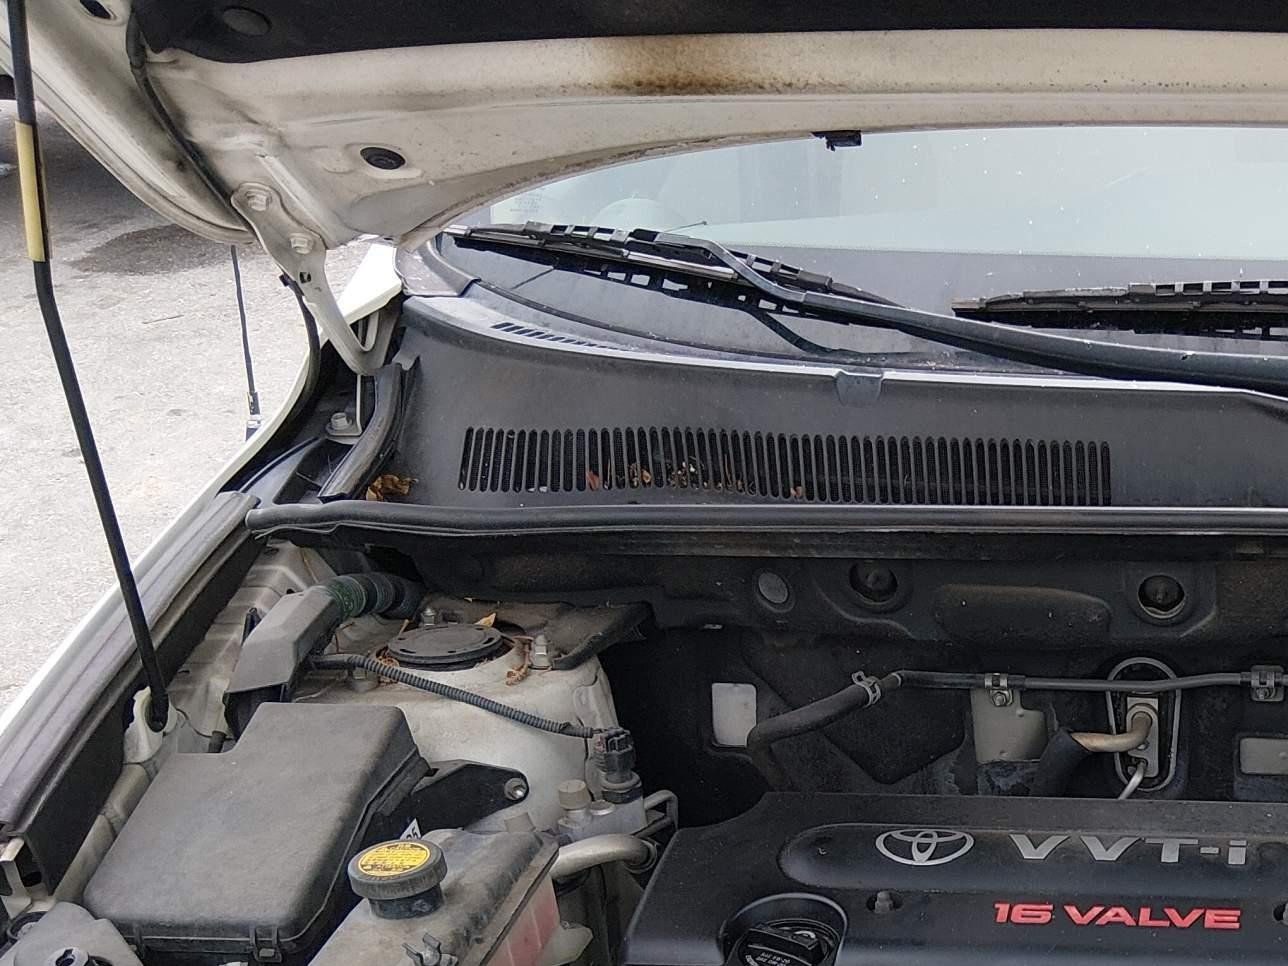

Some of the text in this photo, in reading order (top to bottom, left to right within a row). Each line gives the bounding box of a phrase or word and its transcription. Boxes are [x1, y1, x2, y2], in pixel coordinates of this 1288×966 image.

[1010, 834, 1247, 865] VVT-i
[994, 903, 1241, 928] 16 VALVE
